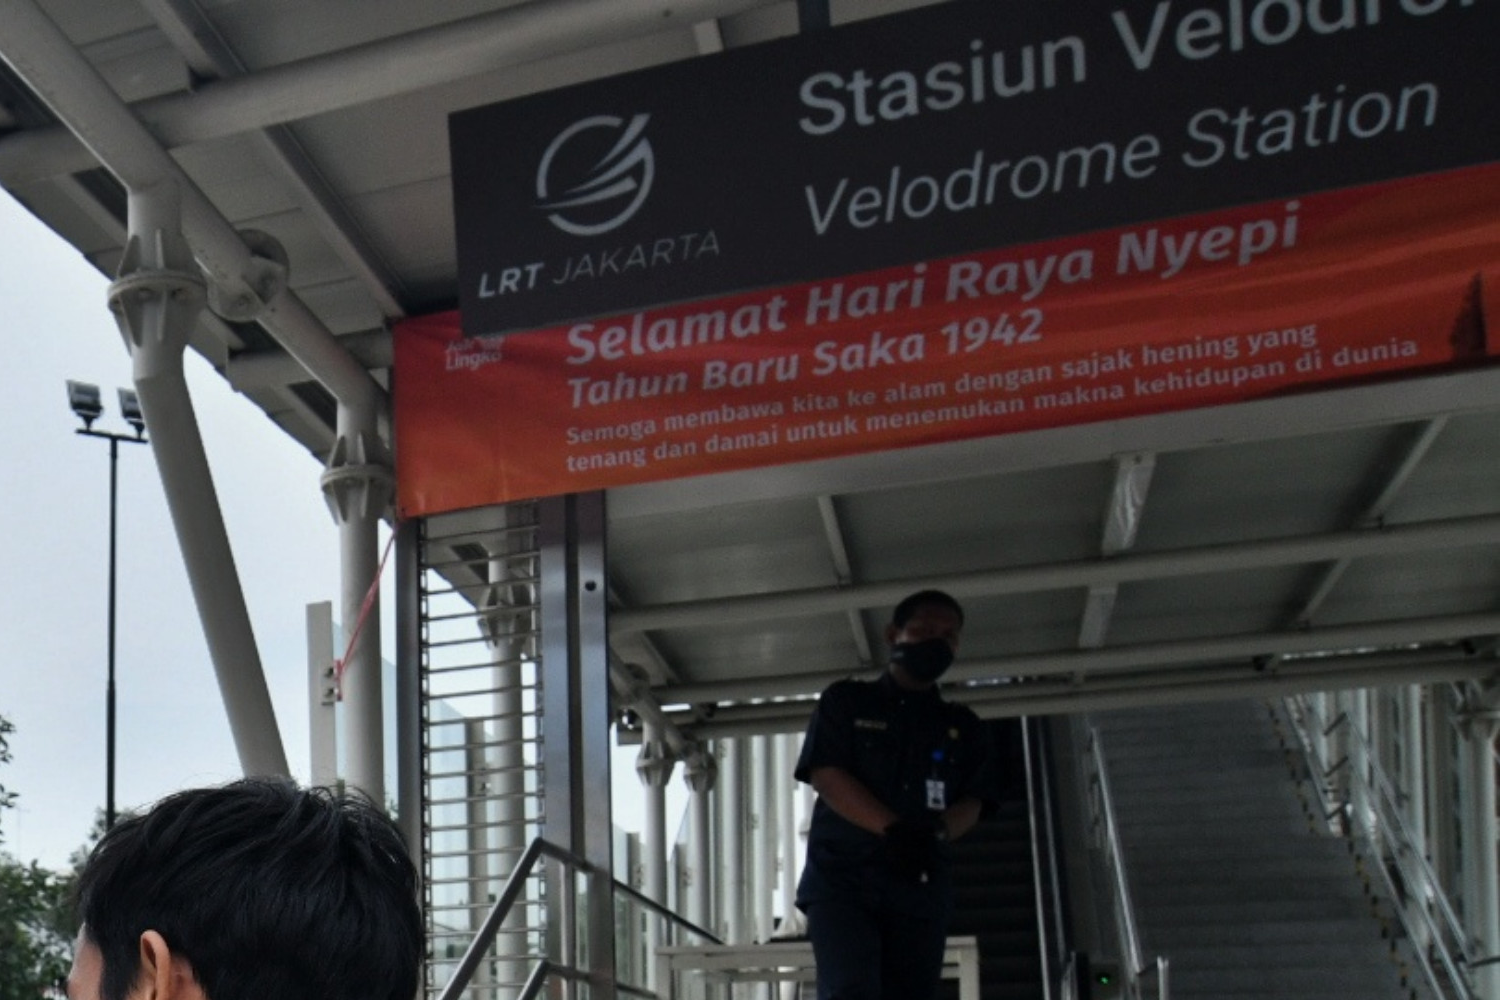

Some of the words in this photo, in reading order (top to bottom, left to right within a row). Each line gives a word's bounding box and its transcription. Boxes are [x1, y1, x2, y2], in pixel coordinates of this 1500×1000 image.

[798, 34, 1087, 137] Stasiun
[803, 133, 1161, 235] Velodrome
[1181, 82, 1440, 168] Station
[477, 262, 545, 300] LRT
[551, 229, 721, 286] JAKARTA
[565, 293, 788, 366] Selamat
[805, 261, 929, 326] Hari
[946, 248, 1095, 304] Raya
[1115, 200, 1301, 280] Nyepi
[566, 418, 657, 445] Semoga
[664, 398, 785, 433] membawa
[792, 391, 840, 414] kita
[848, 389, 878, 408] ke
[884, 379, 946, 405] alam
[954, 363, 1053, 395] dengan
[1061, 348, 1134, 380] sajak
[1141, 335, 1239, 366] hening
[1246, 324, 1318, 353] yang
[566, 446, 647, 473] tenang
[653, 438, 698, 462] dan
[704, 425, 779, 454] damai
[786, 415, 859, 442] untuk
[865, 392, 1026, 432] menemukan
[1033, 380, 1126, 411] makna
[1133, 359, 1287, 398] kehidupan
[1294, 350, 1324, 374] di
[1331, 337, 1419, 368] dunia
[567, 370, 689, 410] Tahun
[701, 353, 800, 391] Baru
[811, 330, 927, 377] Saka
[941, 307, 1045, 355] 1942
